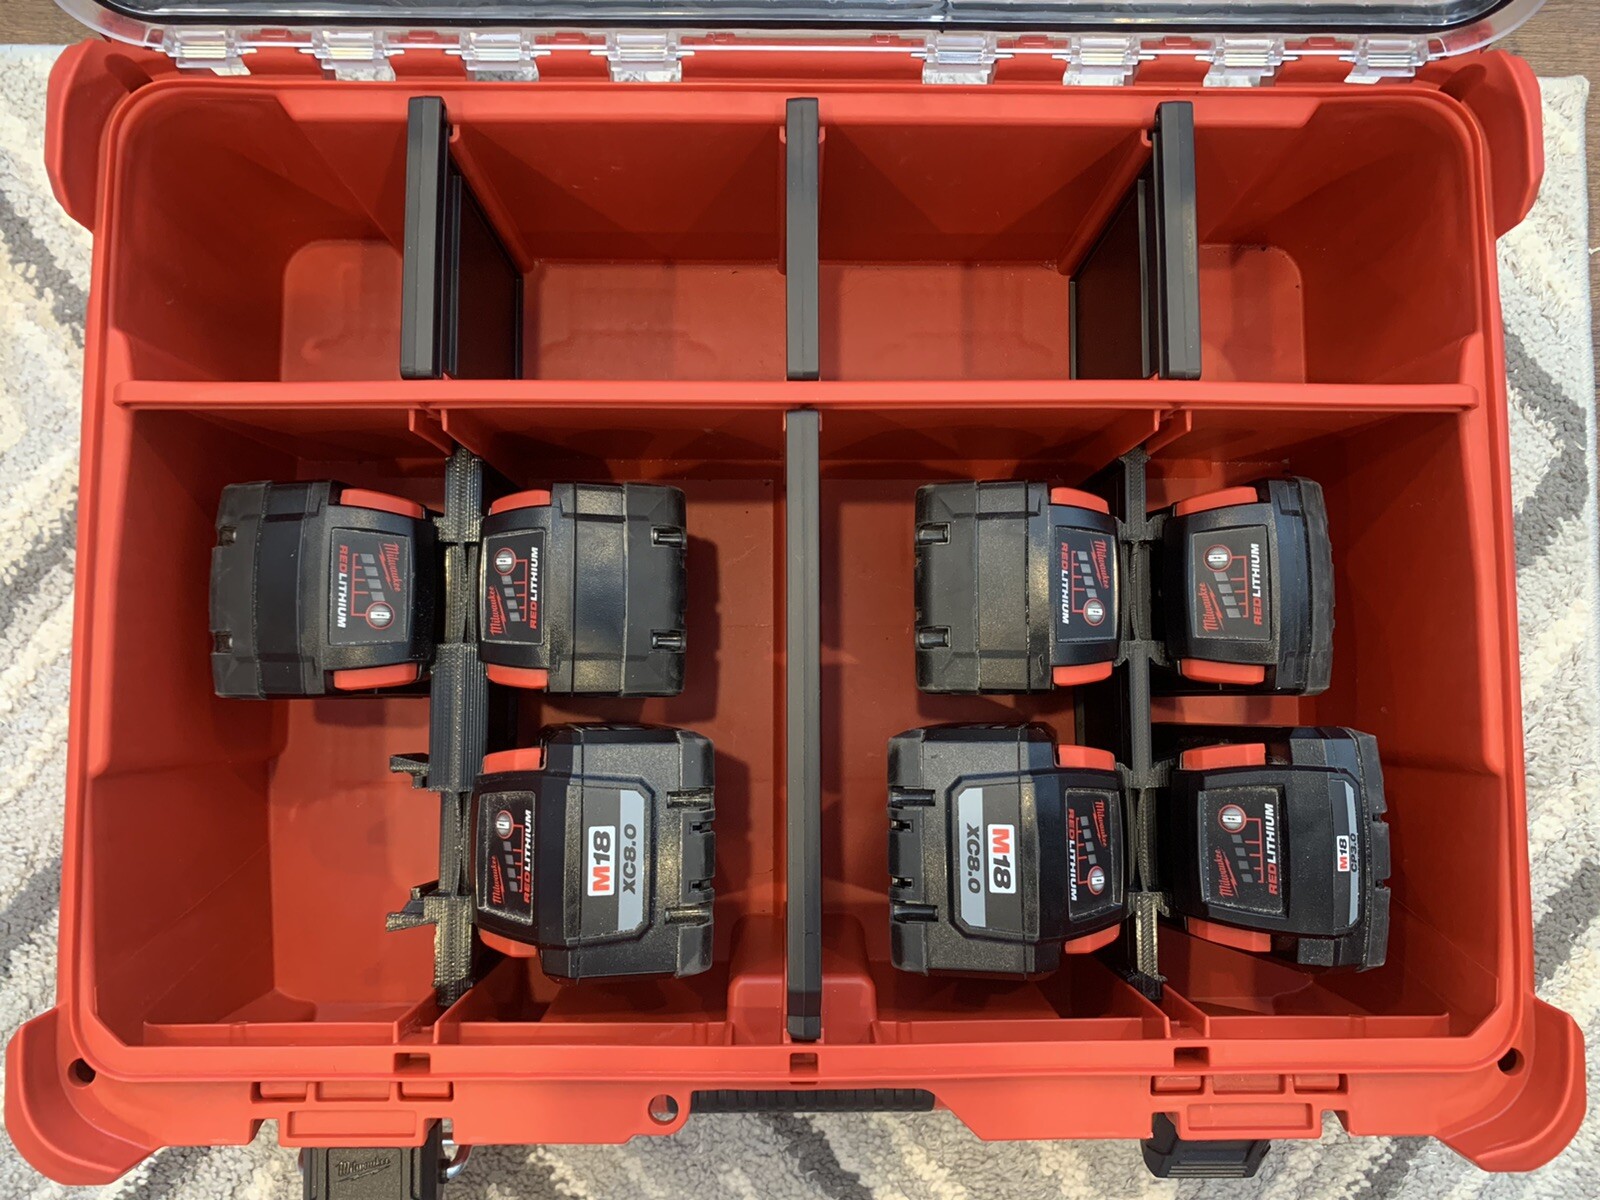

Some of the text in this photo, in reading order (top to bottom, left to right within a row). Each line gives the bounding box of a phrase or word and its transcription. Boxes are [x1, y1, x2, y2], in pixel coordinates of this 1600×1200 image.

[337, 544, 349, 628] REDLITHIUM
[382, 541, 403, 592] Milwaukee
[529, 546, 539, 630] REDLITHIUM
[1061, 542, 1070, 625] REDLITHIUM
[1093, 539, 1110, 589] Milwaukee
[1250, 543, 1263, 626] REDLITHIUM
[487, 585, 503, 636] Milwaukee
[1198, 582, 1219, 633] Milwaukee
[1094, 799, 1108, 848] Milwaukee
[1264, 803, 1279, 896] REDLITHIUM
[1338, 838, 1348, 870] M18
[1350, 832, 1358, 873] CP3.0
[490, 855, 503, 905] Milwaukee
[523, 809, 532, 904] REDLITHIUM
[592, 830, 611, 891] M18
[622, 823, 637, 895] XC8.0
[966, 822, 981, 894] XC8.0
[992, 828, 1012, 890] M18
[1067, 808, 1078, 901] REDLITHIUM
[1214, 845, 1234, 899] Milwaukee
[335, 1156, 392, 1177] Milwaukee
